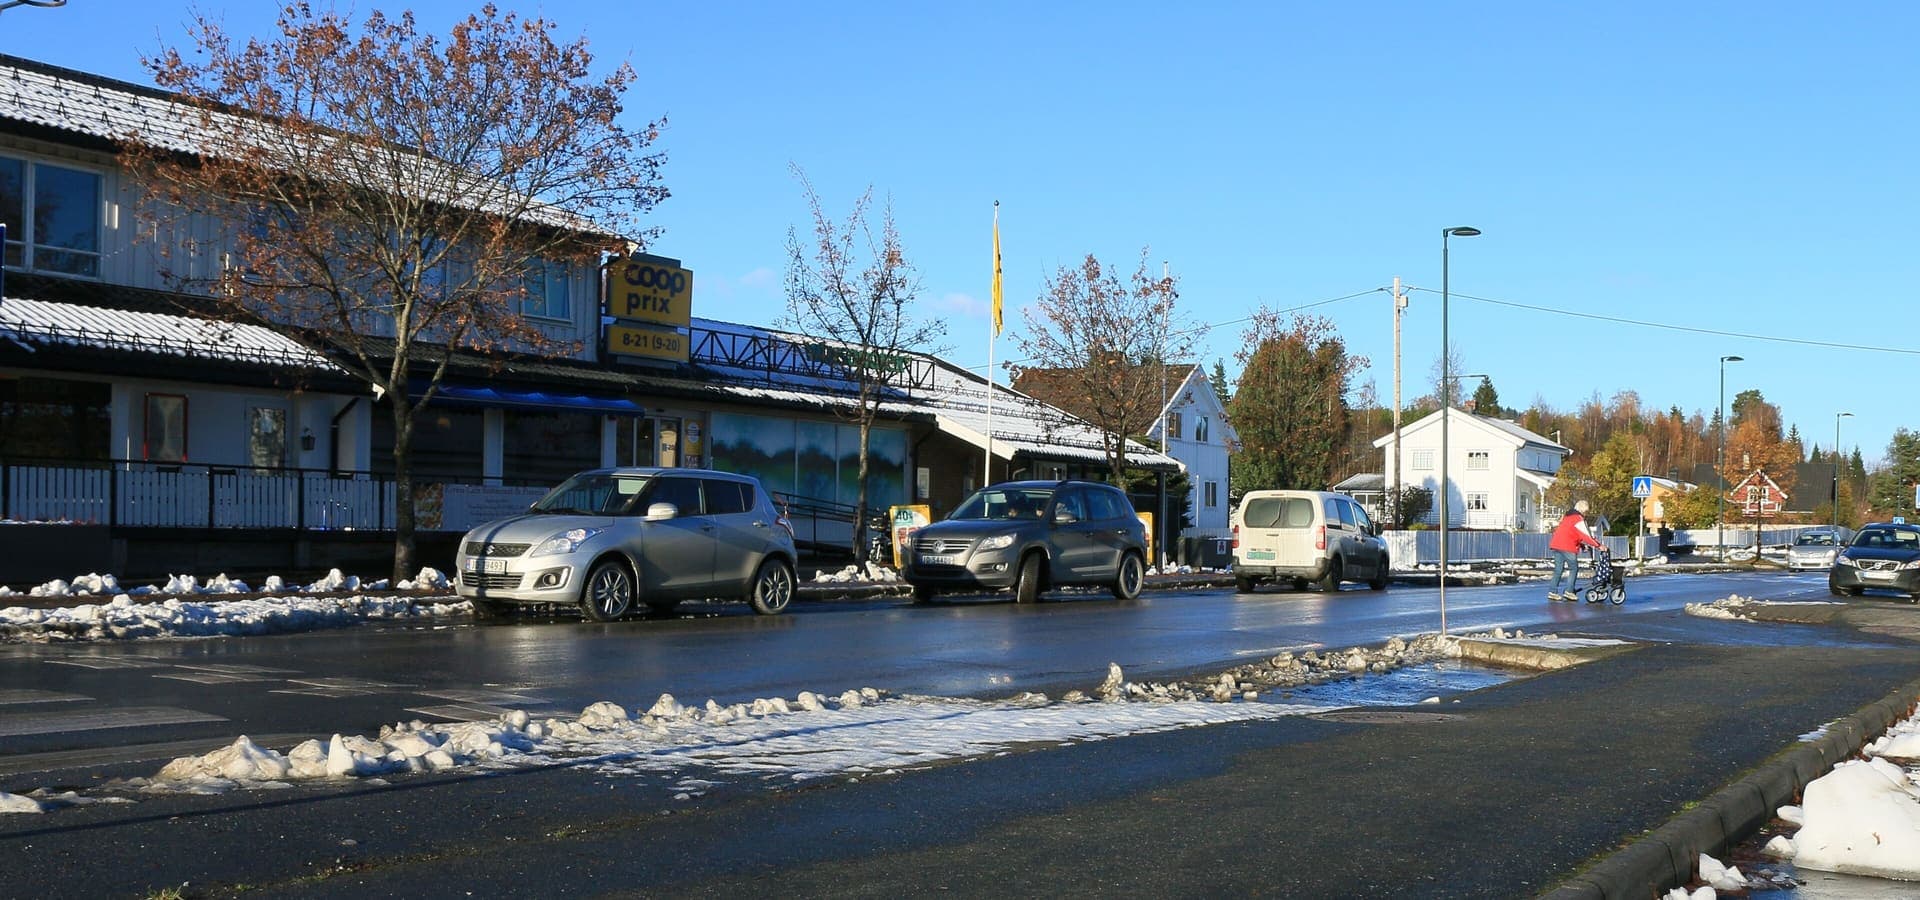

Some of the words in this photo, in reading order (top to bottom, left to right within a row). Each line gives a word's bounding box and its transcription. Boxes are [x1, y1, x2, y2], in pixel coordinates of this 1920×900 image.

[624, 264, 685, 297] coop
[627, 288, 670, 315] prix
[623, 333, 648, 347] 8-21
[652, 335, 680, 353] (9-20)
